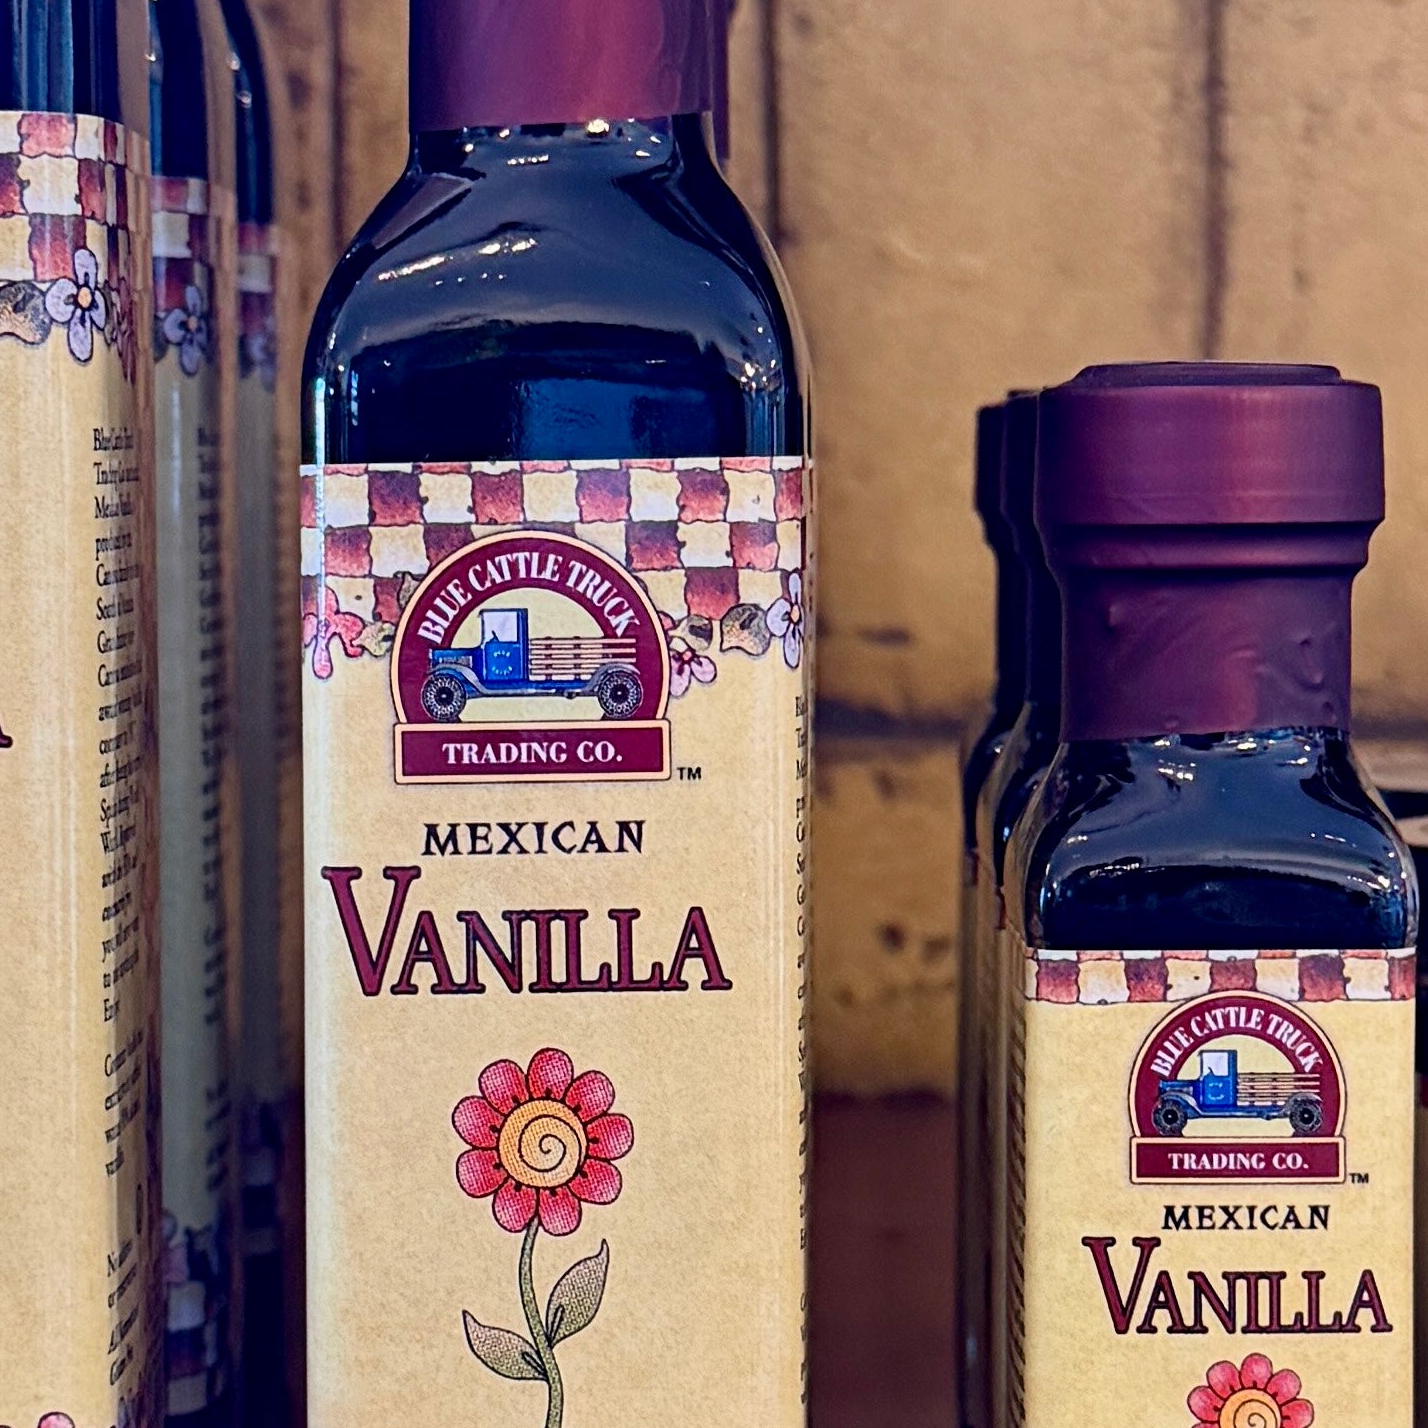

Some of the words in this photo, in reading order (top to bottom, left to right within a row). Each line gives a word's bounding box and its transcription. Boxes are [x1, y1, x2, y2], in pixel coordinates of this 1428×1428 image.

[416, 578, 473, 645] BLUE
[467, 551, 564, 593] CATTLE
[567, 560, 641, 637] TRUCK
[442, 741, 568, 765] TRADING
[576, 740, 623, 763] CO.
[676, 766, 702, 781] TM
[421, 819, 645, 856] MEXICAN
[320, 864, 733, 997] VANILLA
[1150, 1026, 1194, 1077] BLUE
[1190, 1006, 1265, 1037] CATTLE
[1267, 1013, 1324, 1073] TRUCK
[1168, 1152, 1266, 1170] TRADING
[1271, 1152, 1309, 1170] CO.
[1349, 1173, 1369, 1184] TM
[1160, 1204, 1332, 1231] MEXICAN
[1080, 1235, 1394, 1335] VANILLA
